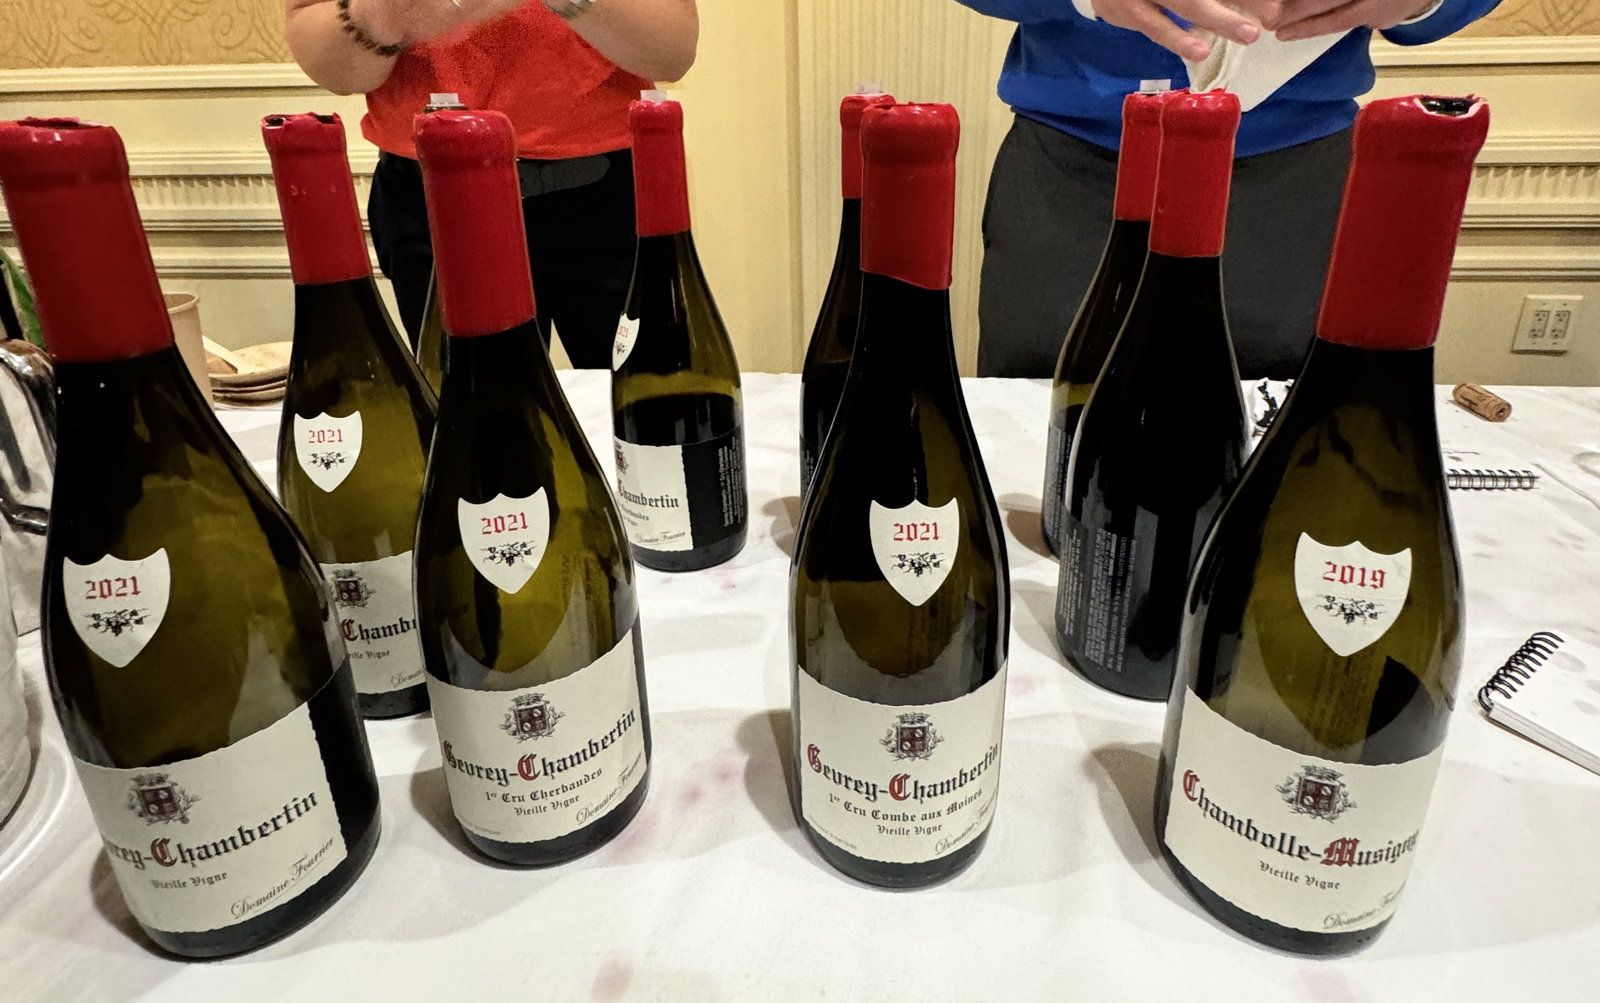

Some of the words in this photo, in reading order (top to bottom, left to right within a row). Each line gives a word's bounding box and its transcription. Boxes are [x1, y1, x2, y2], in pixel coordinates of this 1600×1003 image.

[308, 429, 343, 443] 2021
[481, 512, 529, 535] 2021
[893, 522, 940, 541] 2021
[85, 576, 142, 600] 2021
[1322, 561, 1387, 589] 2019
[443, 709, 636, 786] Gevrey-Chambertin
[502, 792, 525, 803] Cru
[530, 768, 603, 801] Cherbaudes
[807, 743, 999, 805] Gevrey-Chambertin
[513, 806, 548, 817] Vieille
[551, 795, 580, 811] Vigne
[576, 788, 618, 825] Domaine
[844, 801, 866, 817] Cru
[871, 810, 917, 822] Combe
[921, 811, 942, 821] aux
[946, 788, 982, 815] Moines
[876, 825, 911, 836] Vieille
[915, 824, 942, 835] Vigne
[191, 872, 228, 888] Vigne
[230, 879, 290, 920] Domaine
[288, 837, 334, 881] Fourrier
[1259, 860, 1301, 884] Vieille
[1305, 875, 1341, 890] Vigne
